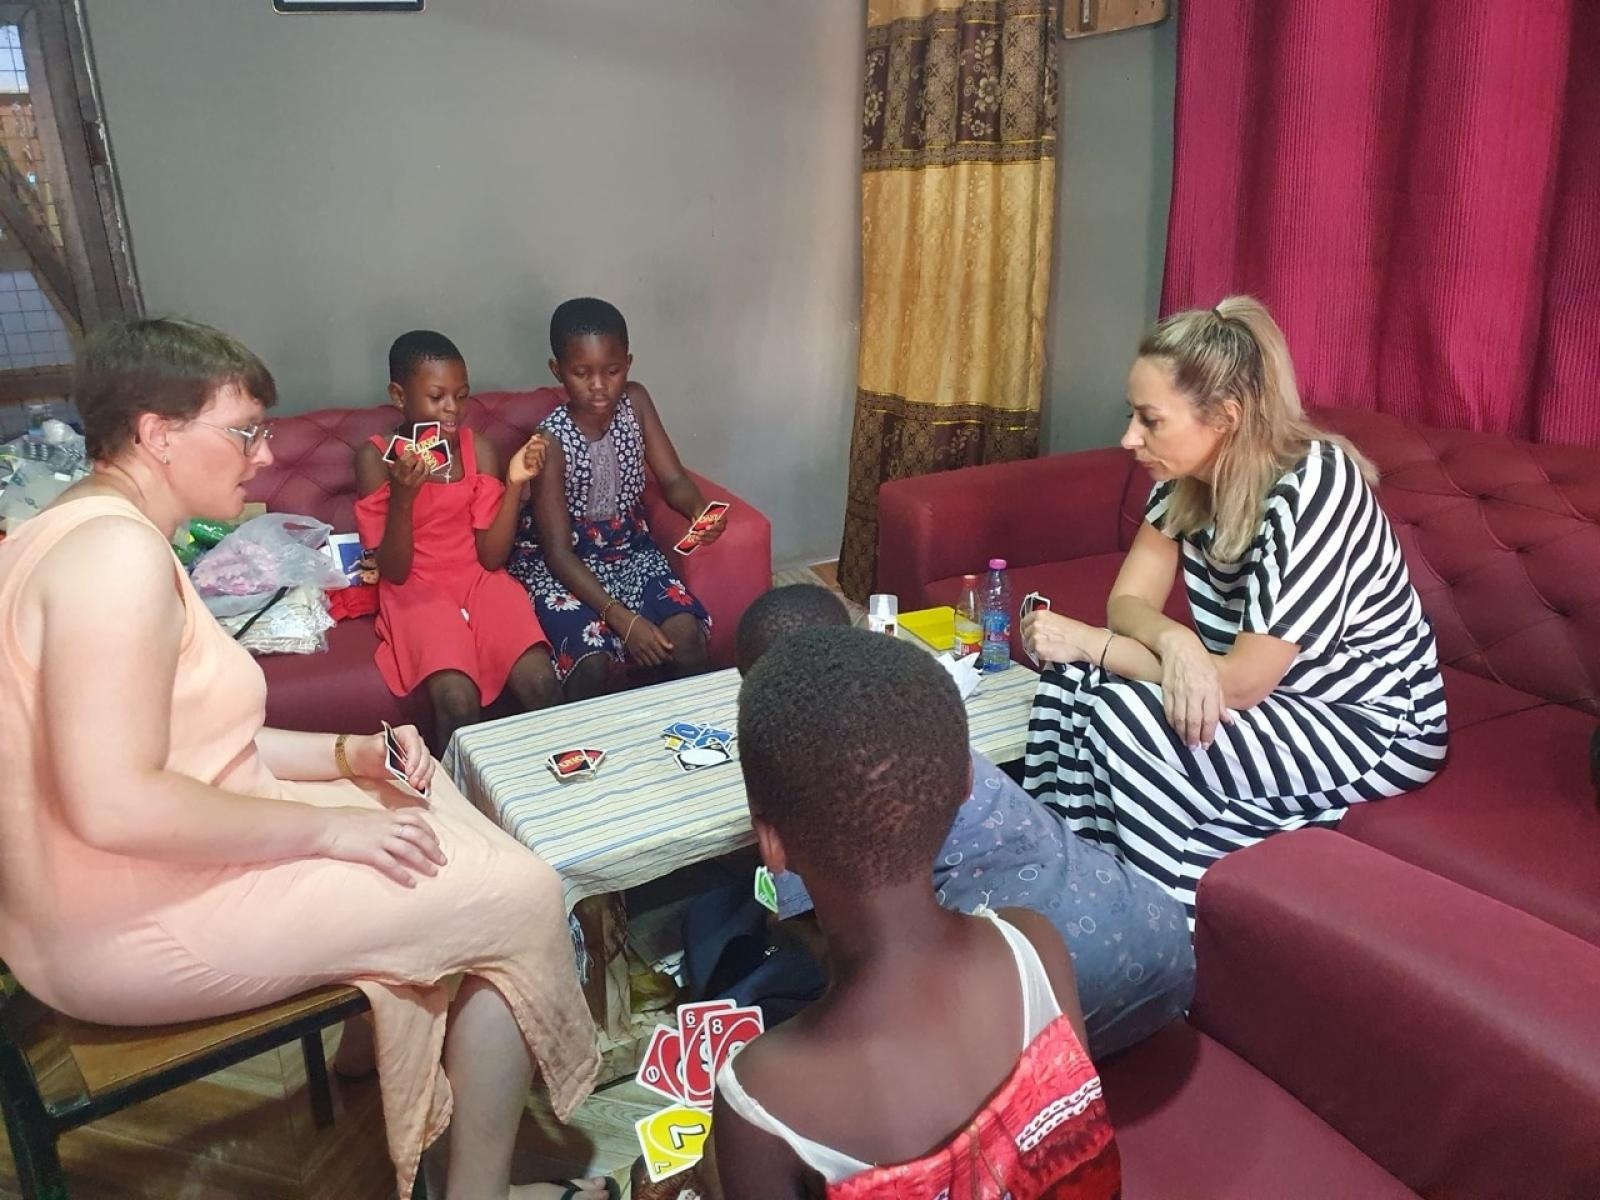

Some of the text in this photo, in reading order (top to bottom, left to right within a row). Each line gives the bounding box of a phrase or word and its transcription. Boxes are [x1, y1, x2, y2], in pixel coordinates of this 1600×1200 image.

[685, 1011, 696, 1027] 6
[712, 1018, 723, 1034] 8
[669, 1124, 705, 1149] 7
[654, 1161, 671, 1173] 7
